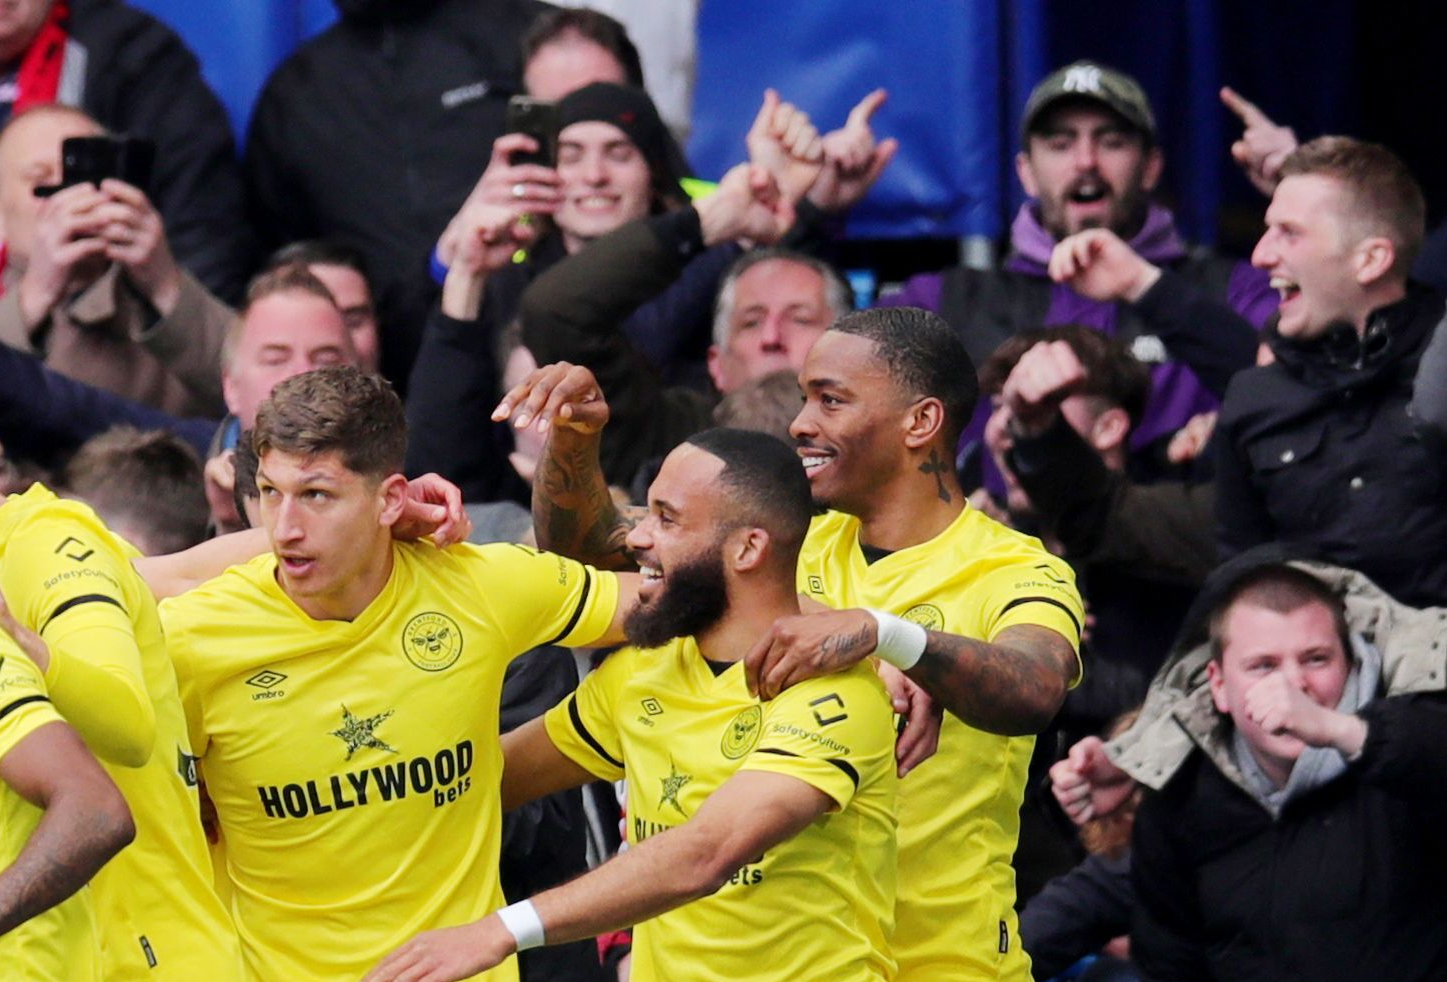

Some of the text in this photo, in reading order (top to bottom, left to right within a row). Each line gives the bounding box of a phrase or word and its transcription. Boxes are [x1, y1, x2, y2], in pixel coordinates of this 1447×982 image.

[252, 689, 284, 700] umbro
[772, 723, 851, 756] SafetyCulture
[258, 740, 473, 819] HOLLYWOOD
[434, 776, 471, 809] bets
[730, 865, 763, 885] ets
